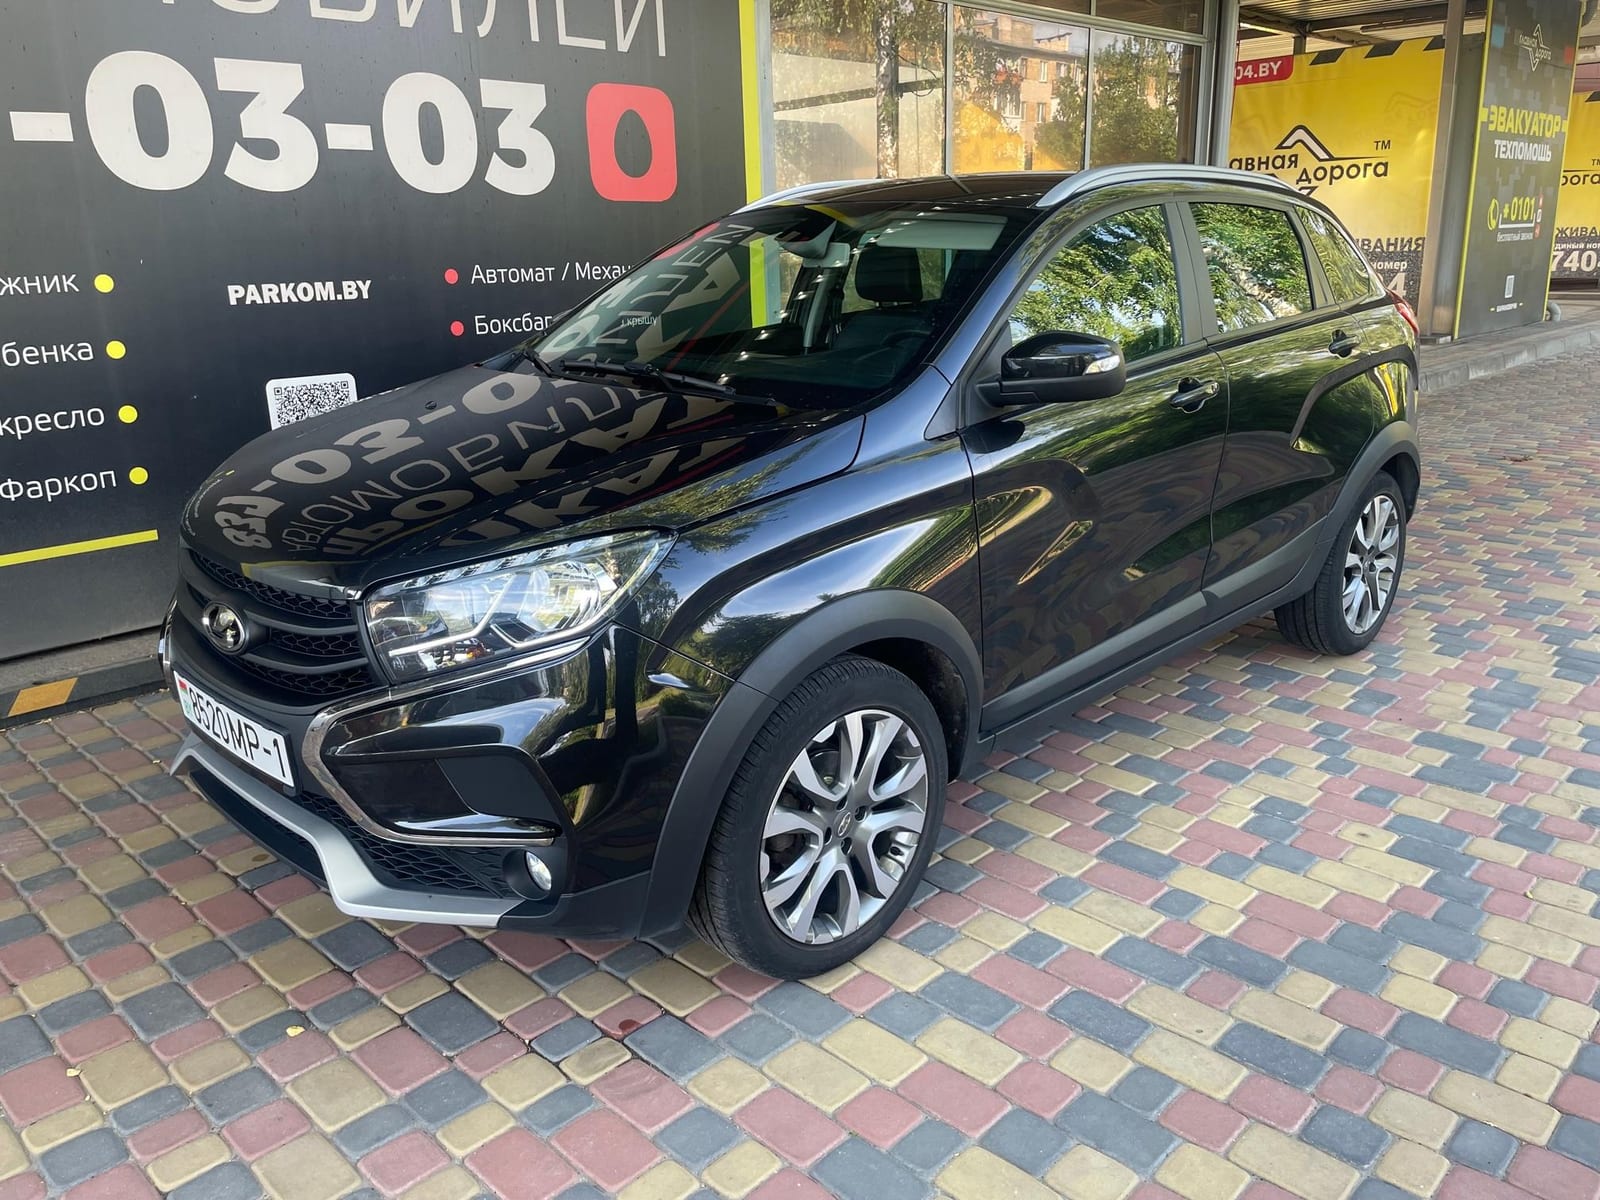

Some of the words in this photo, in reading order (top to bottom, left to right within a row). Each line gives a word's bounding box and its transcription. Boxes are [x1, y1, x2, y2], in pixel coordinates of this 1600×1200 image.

[1488, 104, 1561, 138] ЭВАКУАТОР
[1295, 161, 1389, 185] дорога
[1356, 236, 1426, 253] ВАНИЯ
[1551, 250, 1600, 272] 740
[0, 274, 80, 296] жник
[471, 264, 555, 285] Автомат
[227, 280, 372, 305] PARKOM.BY
[474, 312, 553, 335] Боксбаг
[1, 341, 94, 367] бенка
[0, 407, 105, 440] кресло
[188, 686, 287, 778] 8520MP-1
